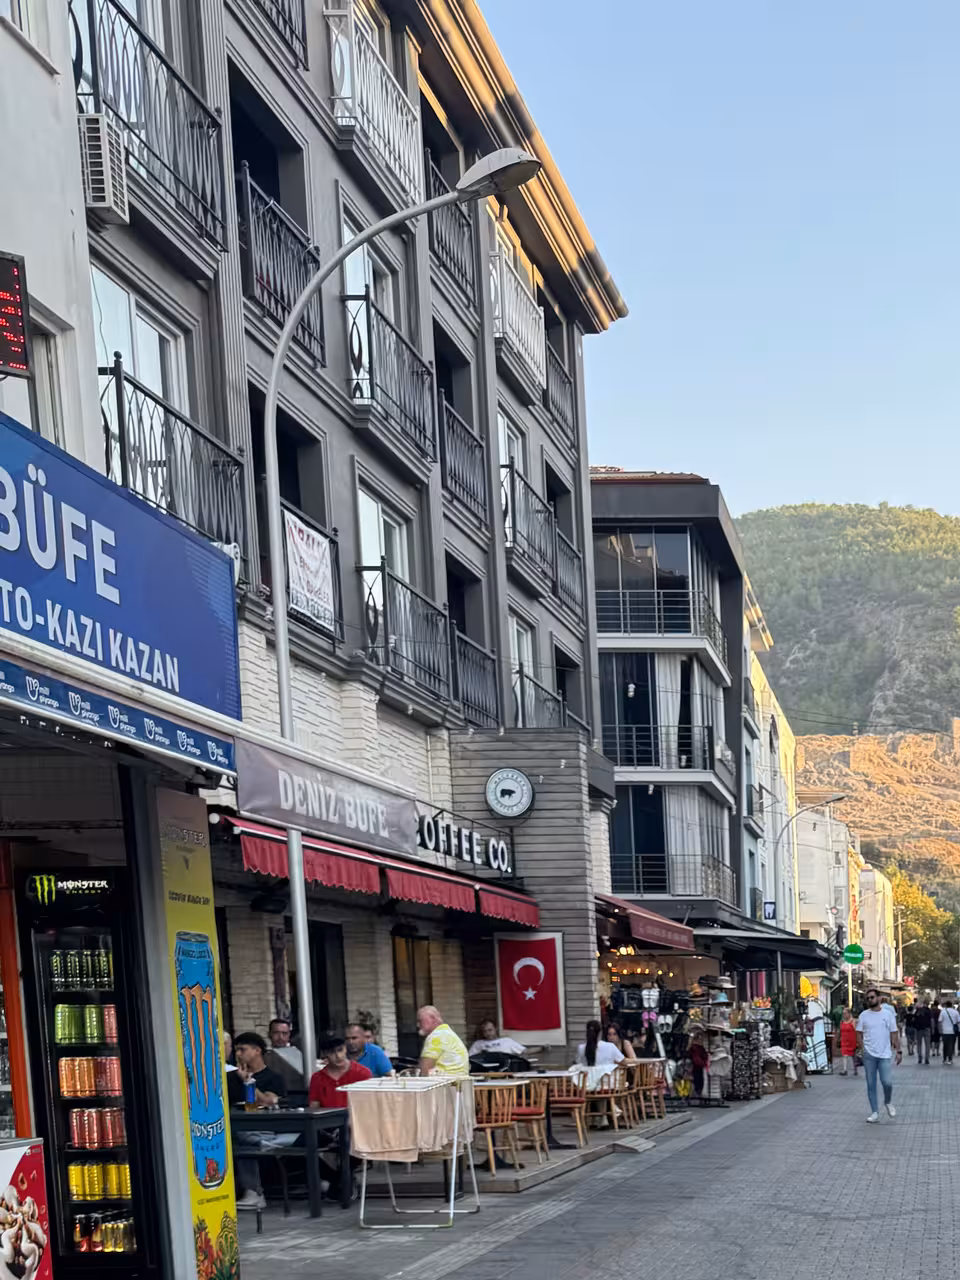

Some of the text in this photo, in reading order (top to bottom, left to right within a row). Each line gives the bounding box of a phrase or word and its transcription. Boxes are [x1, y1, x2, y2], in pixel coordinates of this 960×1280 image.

[109, 628, 180, 693] KAZAN
[278, 769, 340, 824] DENİZ
[489, 837, 512, 873] CO.
[57, 879, 109, 890] MONSTER
